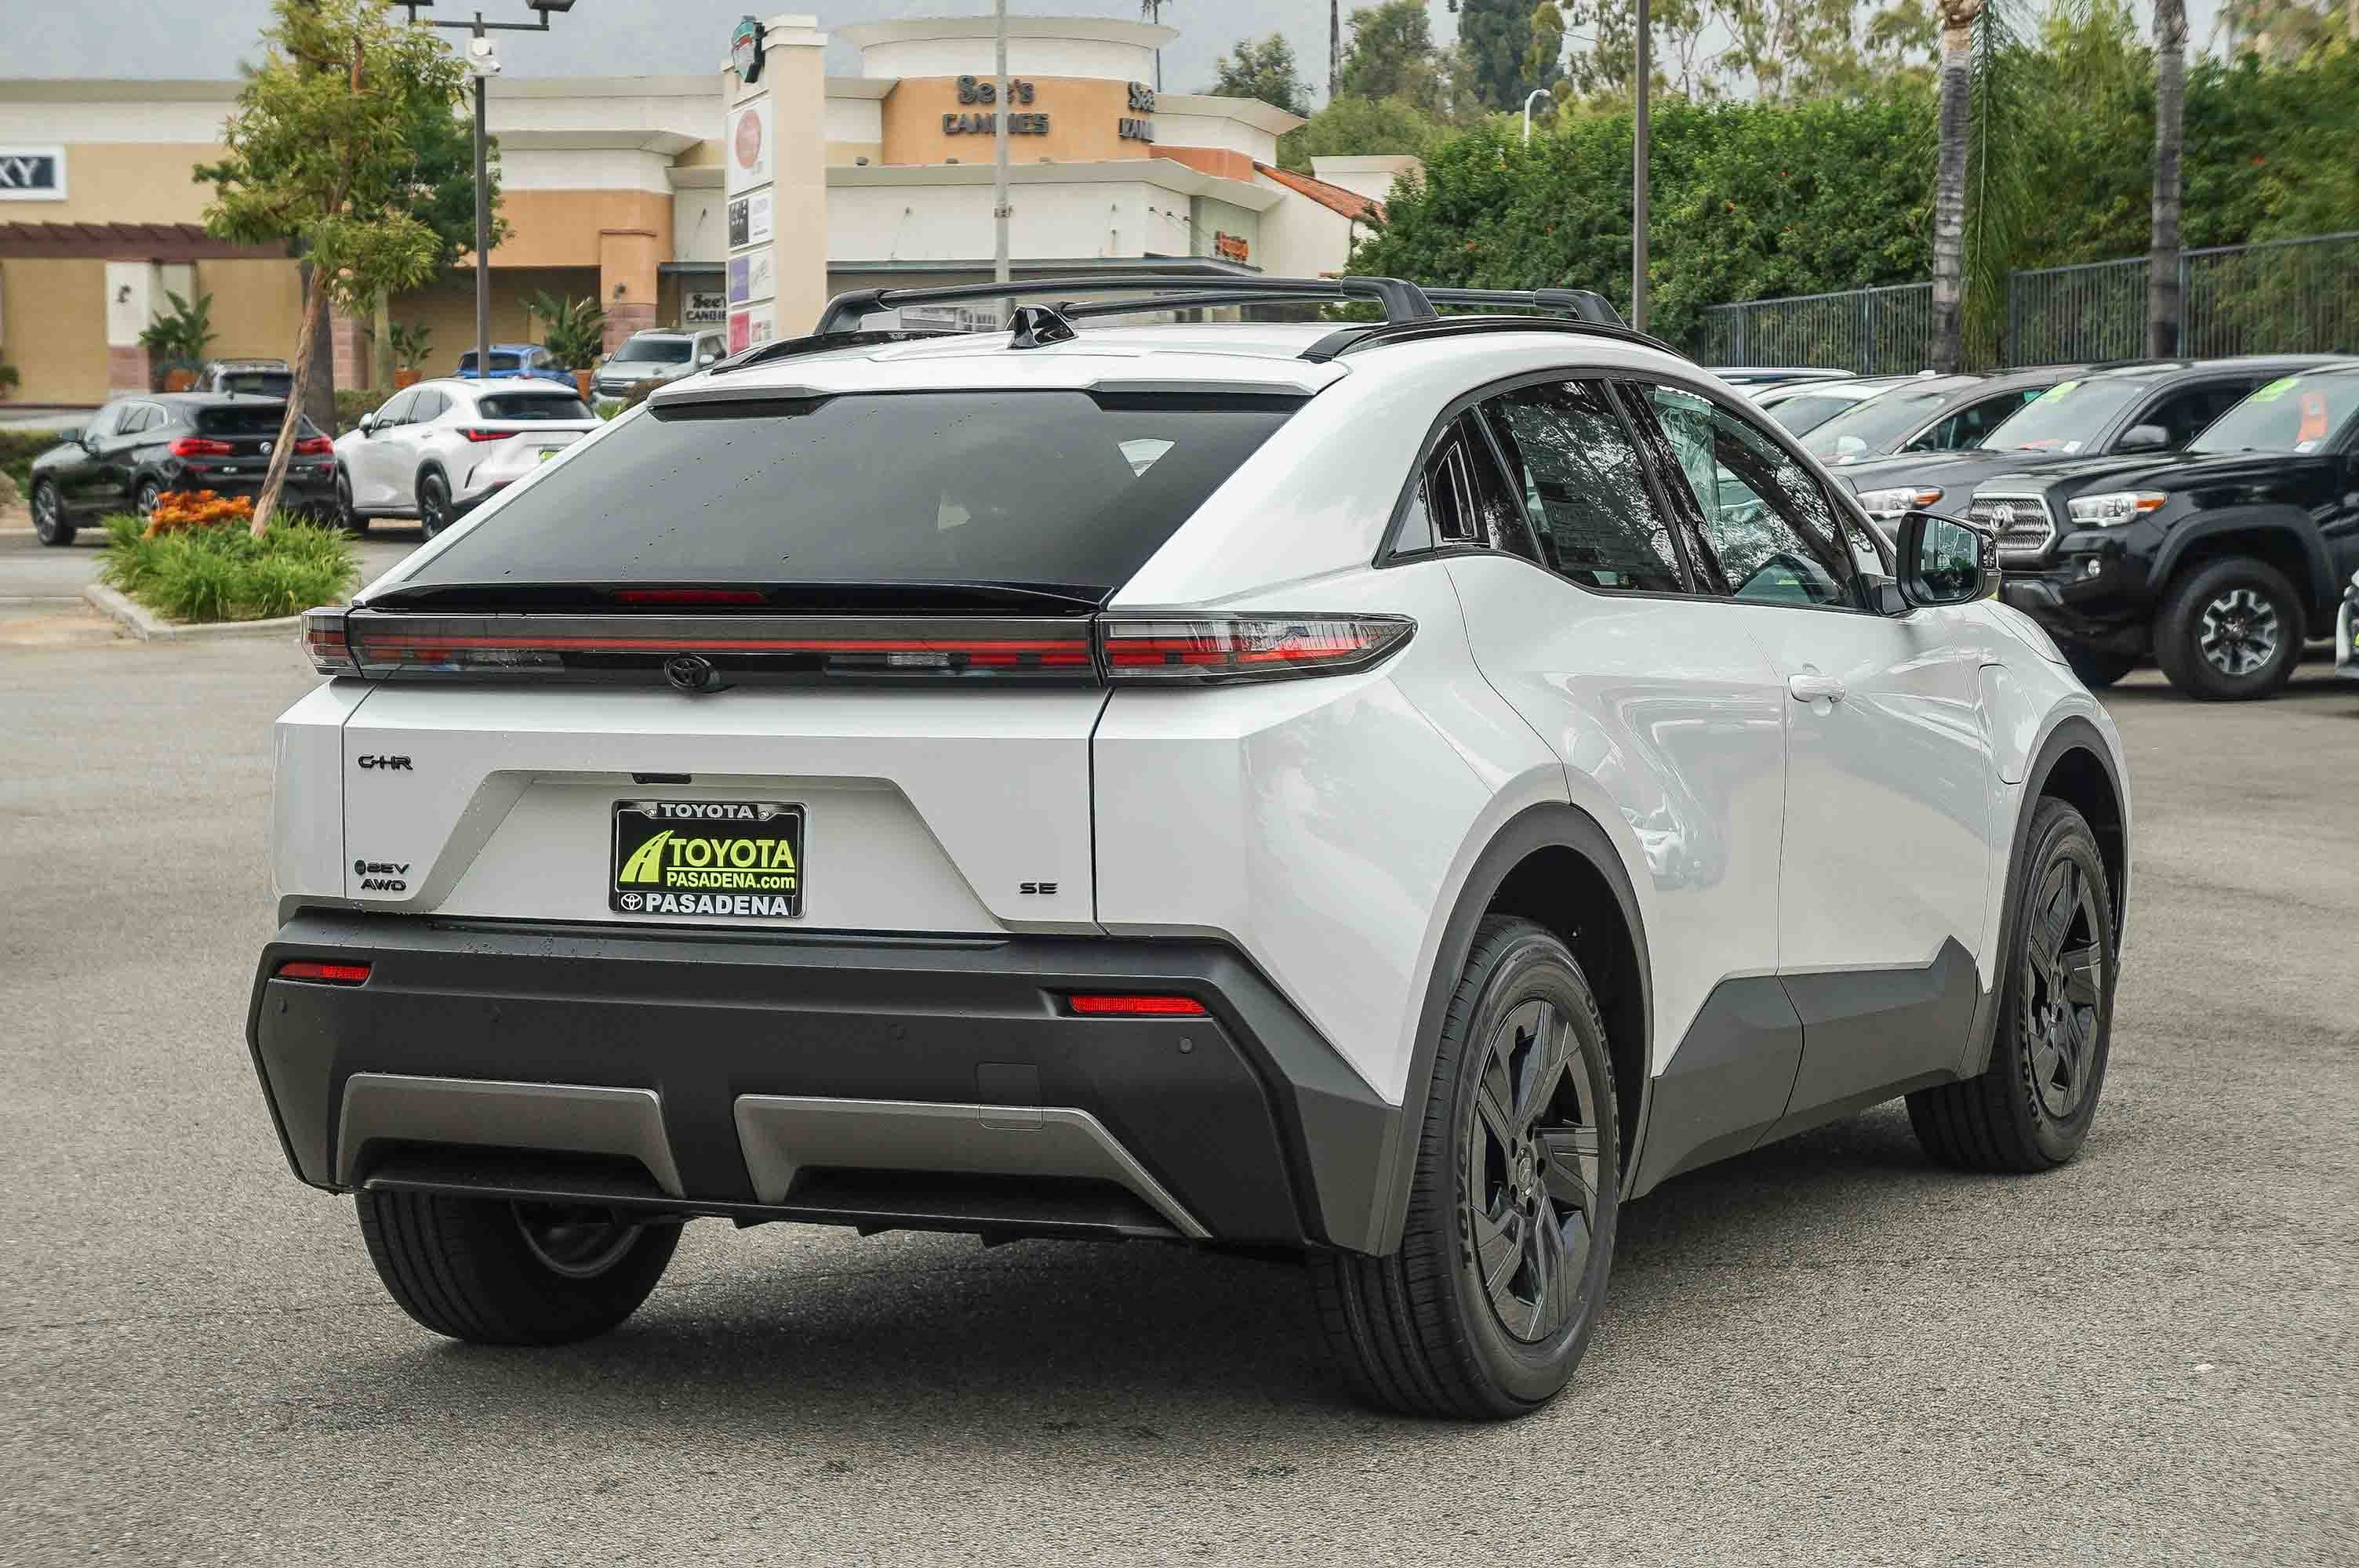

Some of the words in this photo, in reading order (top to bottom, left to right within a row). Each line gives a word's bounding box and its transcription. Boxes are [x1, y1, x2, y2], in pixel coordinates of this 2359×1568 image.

[358, 755, 413, 771] C-HR
[661, 804, 754, 818] TOYOTA
[669, 838, 795, 868] TOYOTA
[361, 878, 407, 891] AWD
[667, 872, 795, 889] PASADENA.com
[1020, 882, 1058, 894] SE
[646, 893, 789, 916] PASADENA
